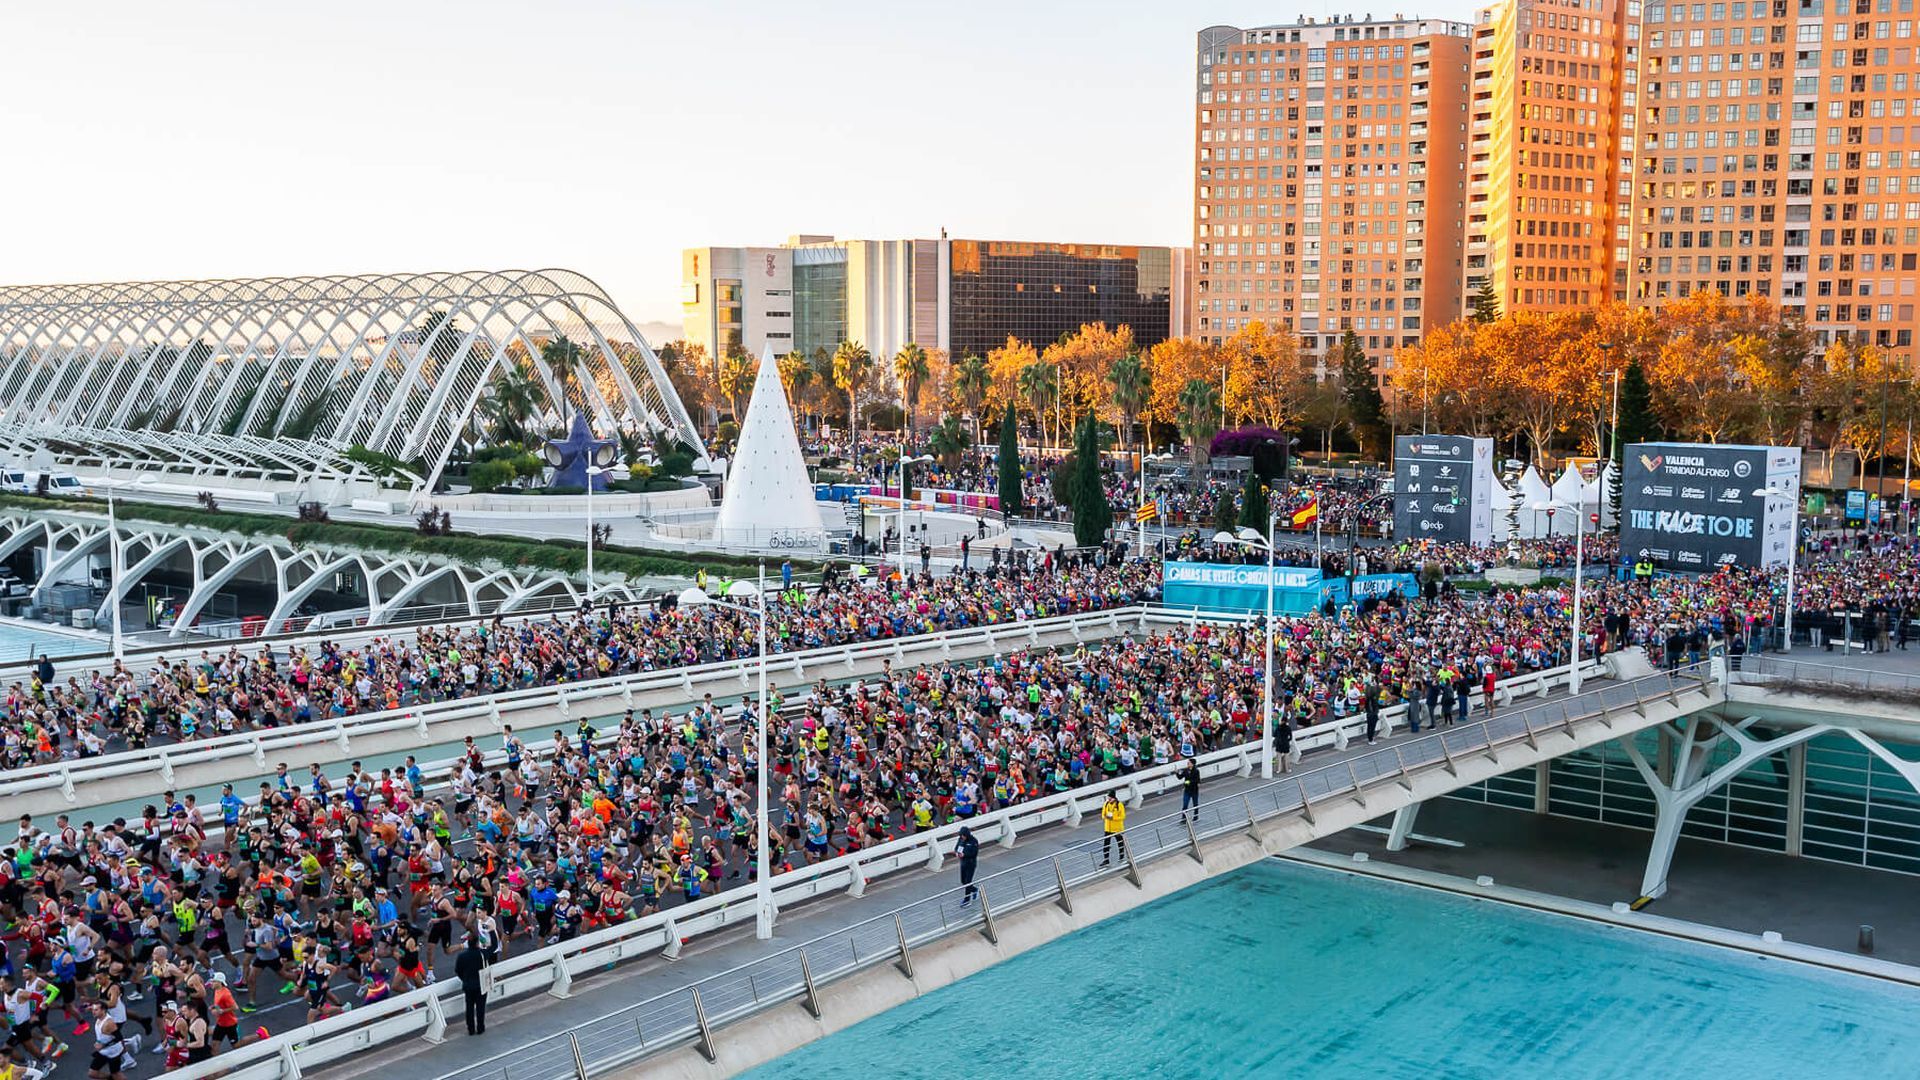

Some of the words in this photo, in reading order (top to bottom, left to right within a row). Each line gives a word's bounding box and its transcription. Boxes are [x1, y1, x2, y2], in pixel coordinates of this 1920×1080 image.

[1665, 455, 1704, 466] VALENCIA
[1664, 466, 1695, 476] TRINIDAD
[1695, 467, 1730, 478] ALFONSO
[1630, 509, 1654, 530] THE
[1655, 510, 1706, 534] RACE
[1707, 515, 1734, 536] TO
[1735, 517, 1754, 538] BE
[1202, 569, 1213, 582] DE
[1274, 572, 1285, 586] LA
